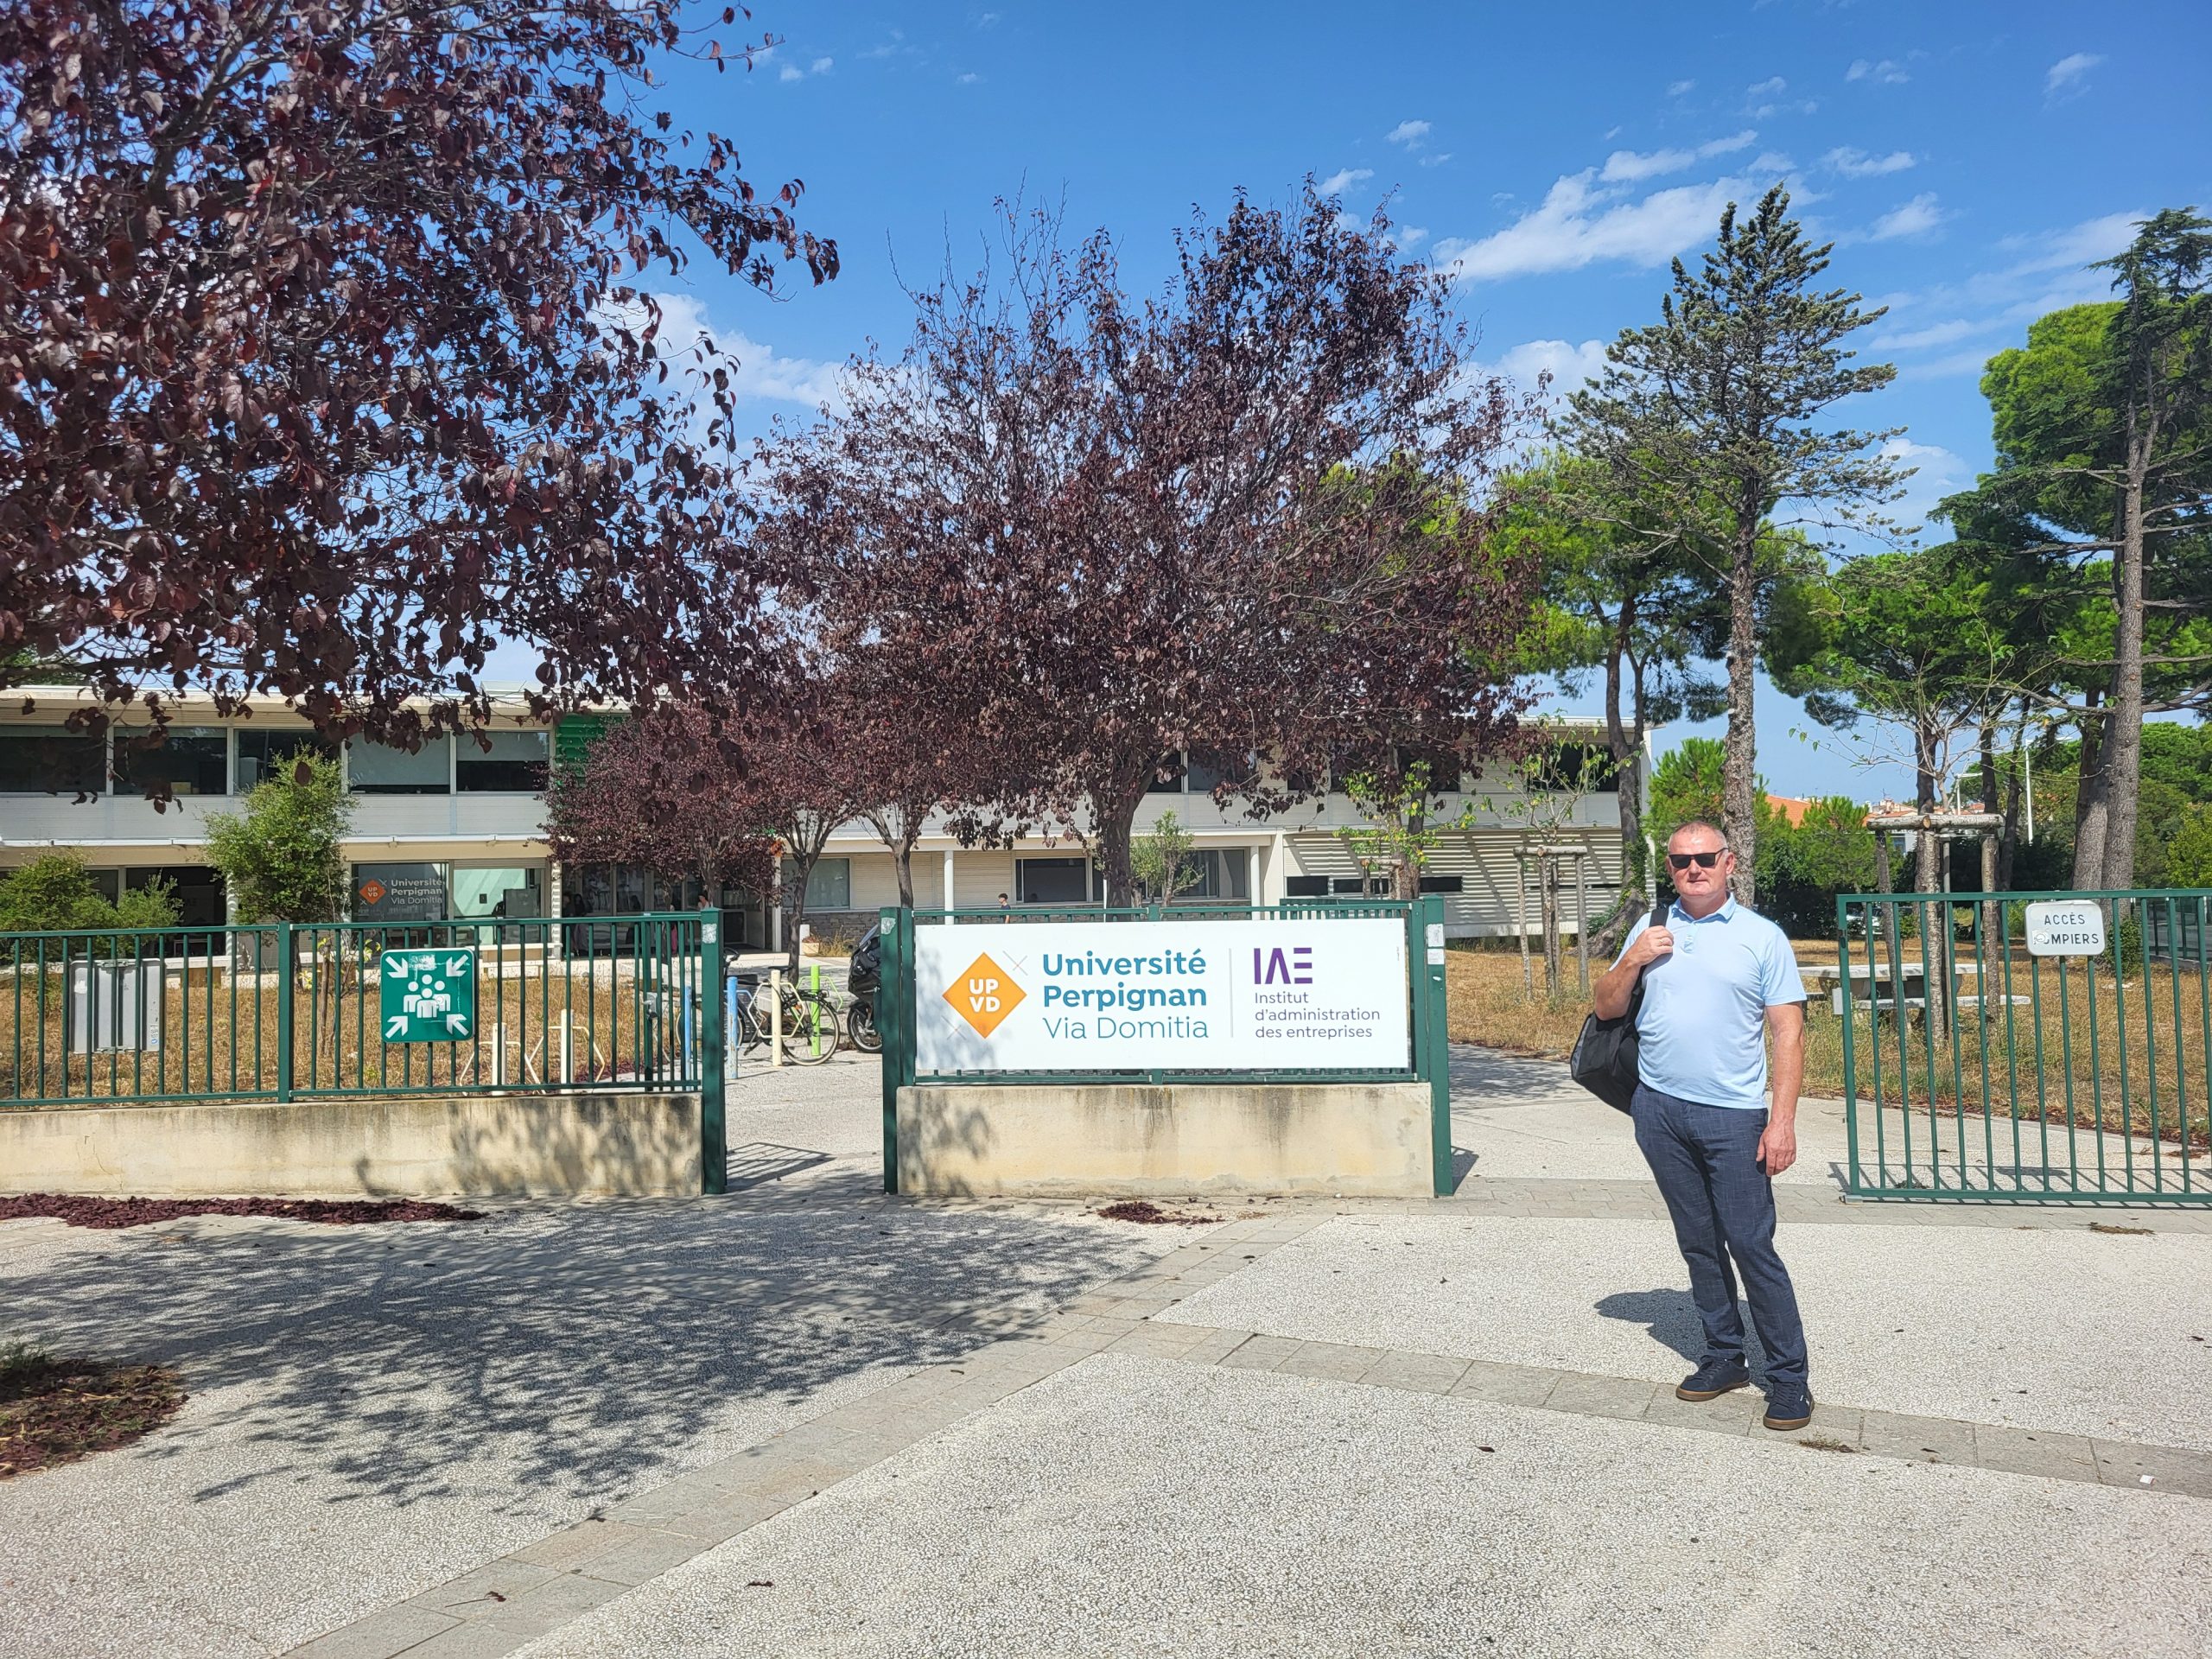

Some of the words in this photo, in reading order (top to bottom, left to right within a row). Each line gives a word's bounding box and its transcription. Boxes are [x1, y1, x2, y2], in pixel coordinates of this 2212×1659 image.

[391, 878, 442, 887] Université
[391, 887, 442, 896] Perpignan
[2044, 912, 2085, 925] ACCÈS
[2033, 933, 2099, 944] MPIERS
[1043, 948, 1206, 976] Université
[1254, 947, 1313, 984] IAE
[969, 979, 999, 995] UP
[1043, 982, 1207, 1012] Perpignan
[1255, 991, 1309, 1004] Institut
[969, 996, 1001, 1013] VD
[1255, 1007, 1381, 1020] d'administration
[1042, 1017, 1086, 1039] Via
[1096, 1016, 1208, 1039] Domitia
[1255, 1026, 1281, 1038] des
[1287, 1025, 1372, 1039] entreprises
